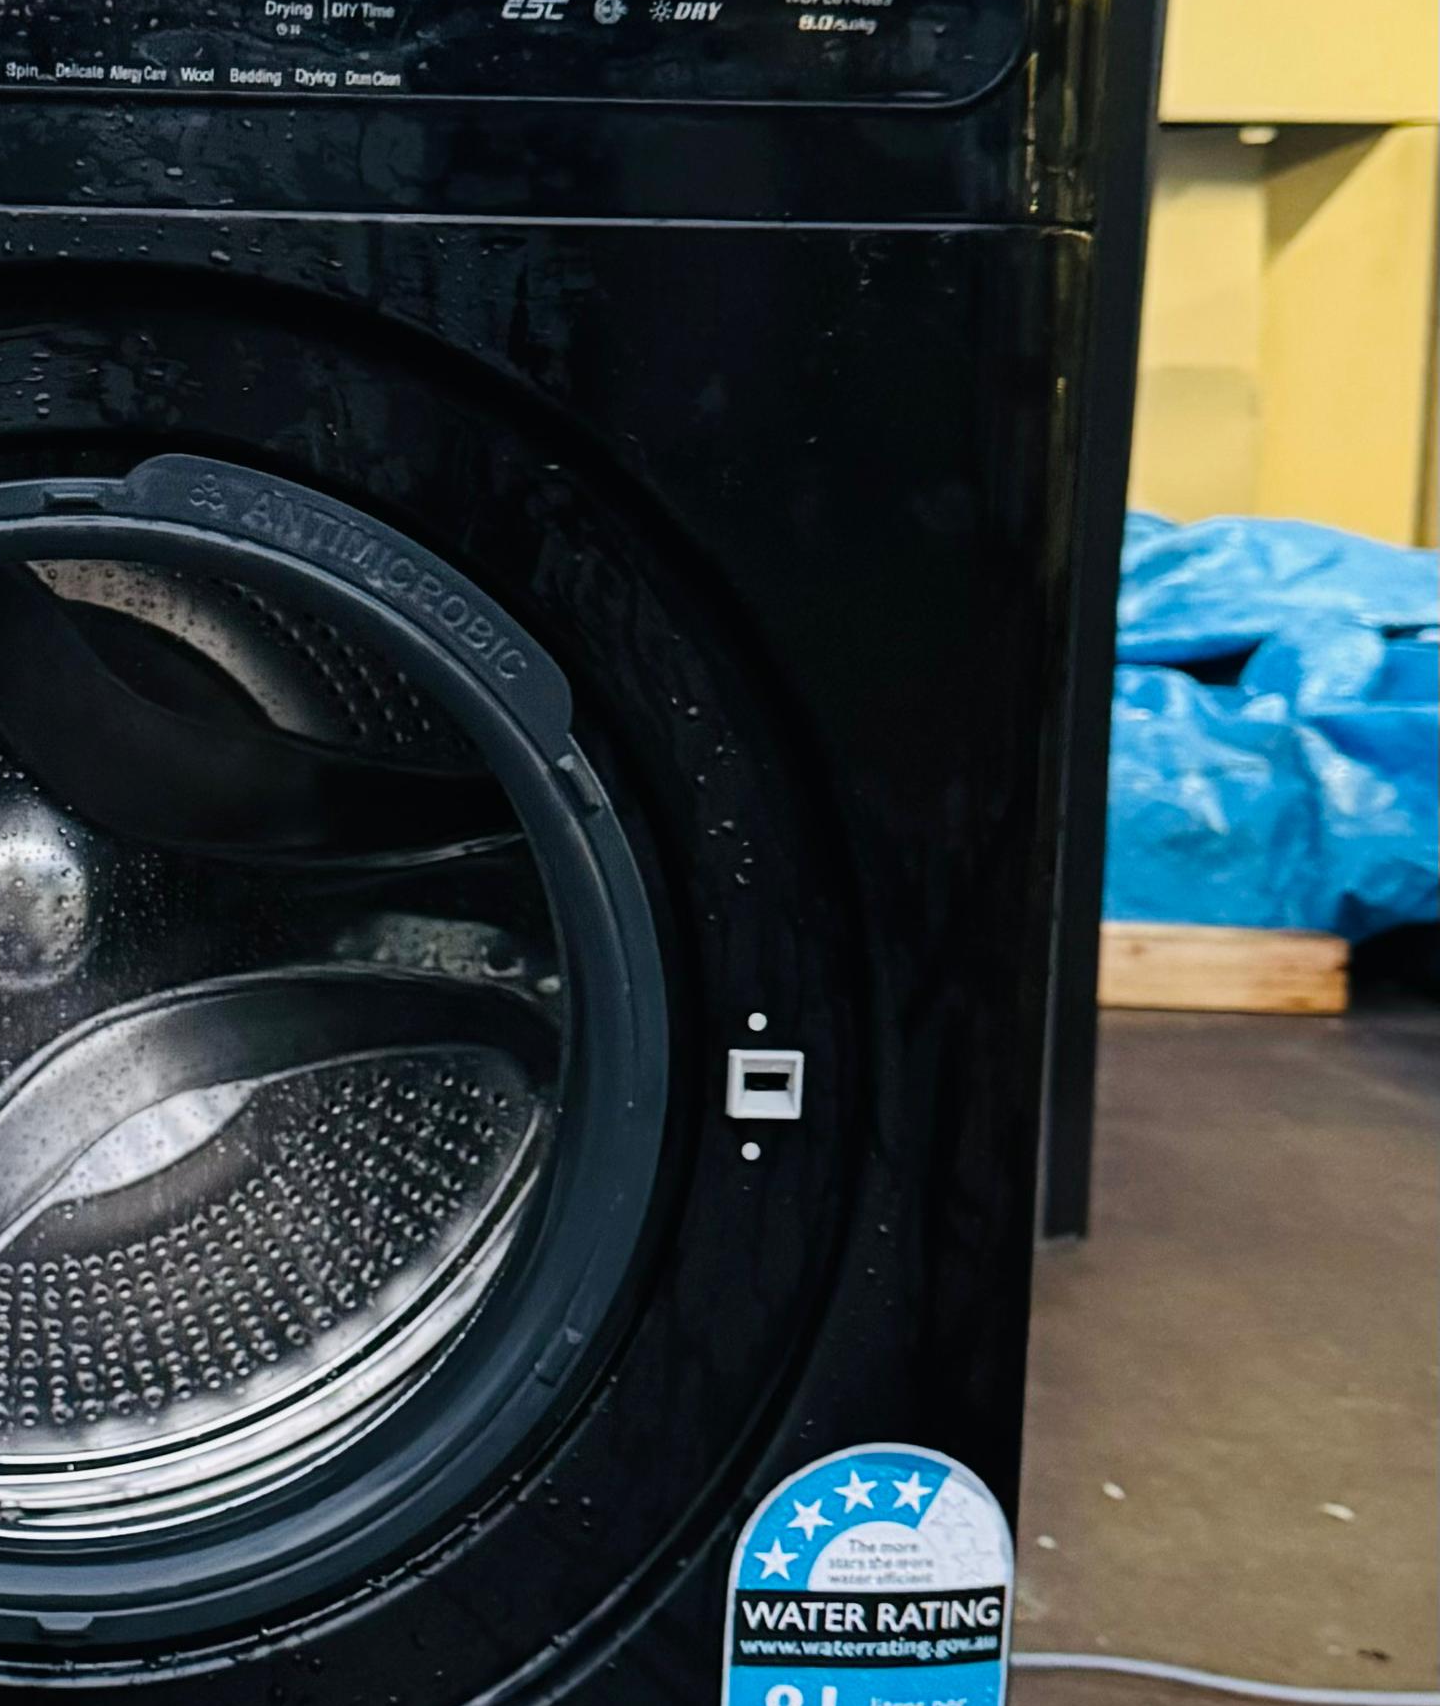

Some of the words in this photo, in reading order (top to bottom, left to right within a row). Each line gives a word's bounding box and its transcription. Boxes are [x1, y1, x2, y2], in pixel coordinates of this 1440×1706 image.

[265, 0, 313, 20] Drying
[332, 2, 357, 17] DIY
[361, 3, 395, 18] Time
[673, 1, 723, 22] DRY
[5, 63, 39, 78] Spin
[56, 63, 104, 78] Delicate
[110, 66, 142, 83] Allergy
[144, 66, 166, 81] Care
[181, 67, 214, 82] Wool
[230, 68, 282, 86] Bedding
[295, 69, 336, 87] Drying
[849, 1538, 874, 1553] The
[880, 1542, 918, 1553] more
[829, 1558, 865, 1569] stars
[868, 1556, 892, 1569] the
[895, 1559, 934, 1569] more
[828, 1574, 871, 1584] water
[875, 1571, 933, 1584] efficient
[742, 1600, 866, 1633] WATER
[877, 1597, 1001, 1632] RATING
[740, 1636, 998, 1660] www.waterrating.gov.au
